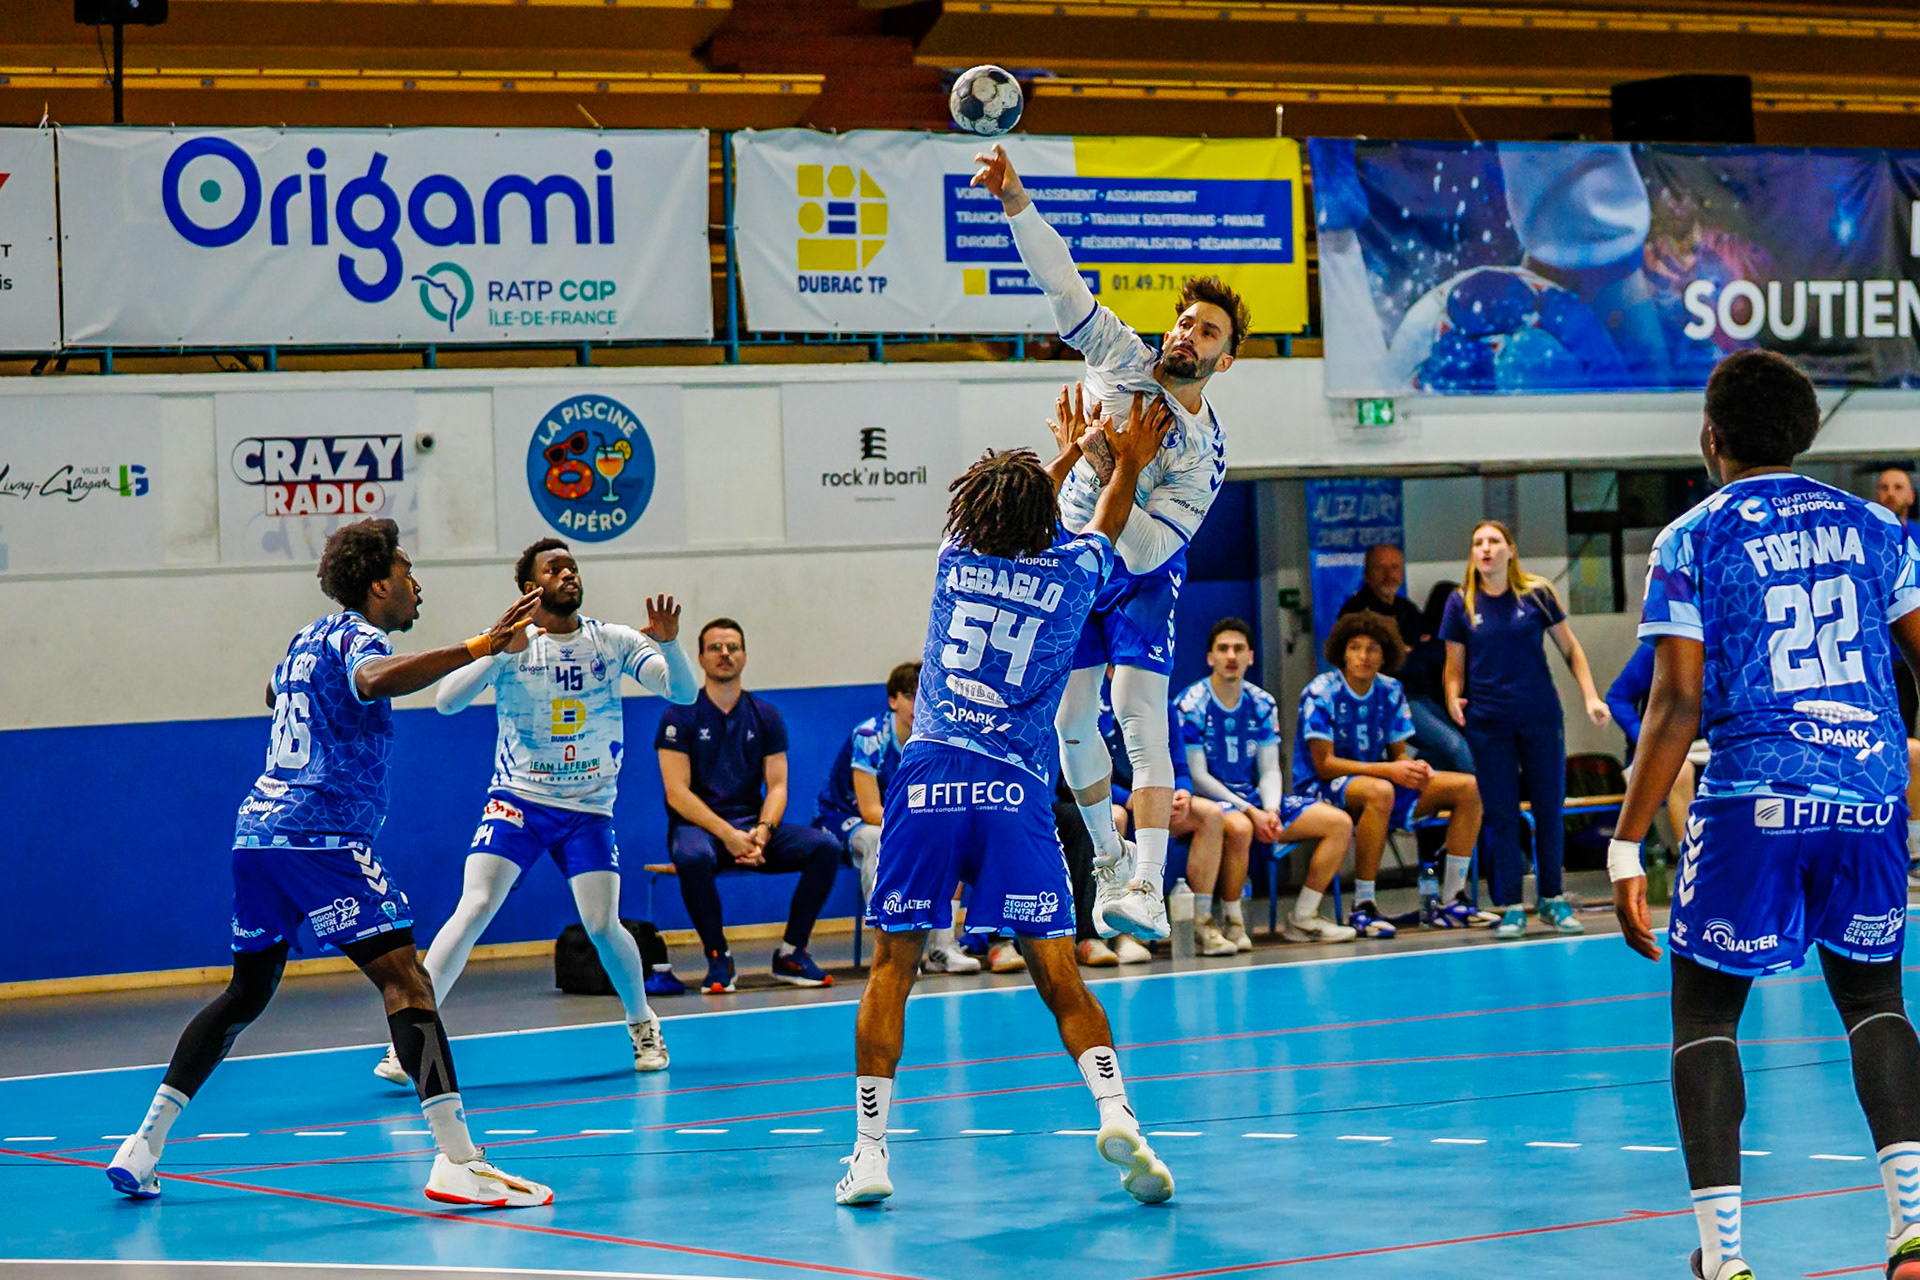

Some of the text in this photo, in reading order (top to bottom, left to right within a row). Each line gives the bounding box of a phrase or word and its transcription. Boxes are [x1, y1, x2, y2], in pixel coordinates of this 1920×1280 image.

[162, 137, 615, 303] Origami
[488, 280, 553, 301] RATP
[798, 275, 888, 293] DUBRAC TP
[489, 308, 617, 326] ÎLE-DE-FRANCE
[538, 401, 638, 446] LA PISCINE
[232, 436, 402, 484] CRAZY
[884, 465, 927, 485] baril
[266, 482, 385, 515] RADIO
[1771, 491, 1831, 507] CHARTRES
[558, 508, 627, 532] APÉRO
[1744, 526, 1865, 577] FOFANA
[946, 566, 1064, 613] AGBAGLO
[942, 600, 1045, 687] 54
[1764, 574, 1866, 692] 22
[555, 666, 583, 691] 45
[530, 760, 554, 771] JEAN
[1702, 929, 1778, 953] AQUALTER
